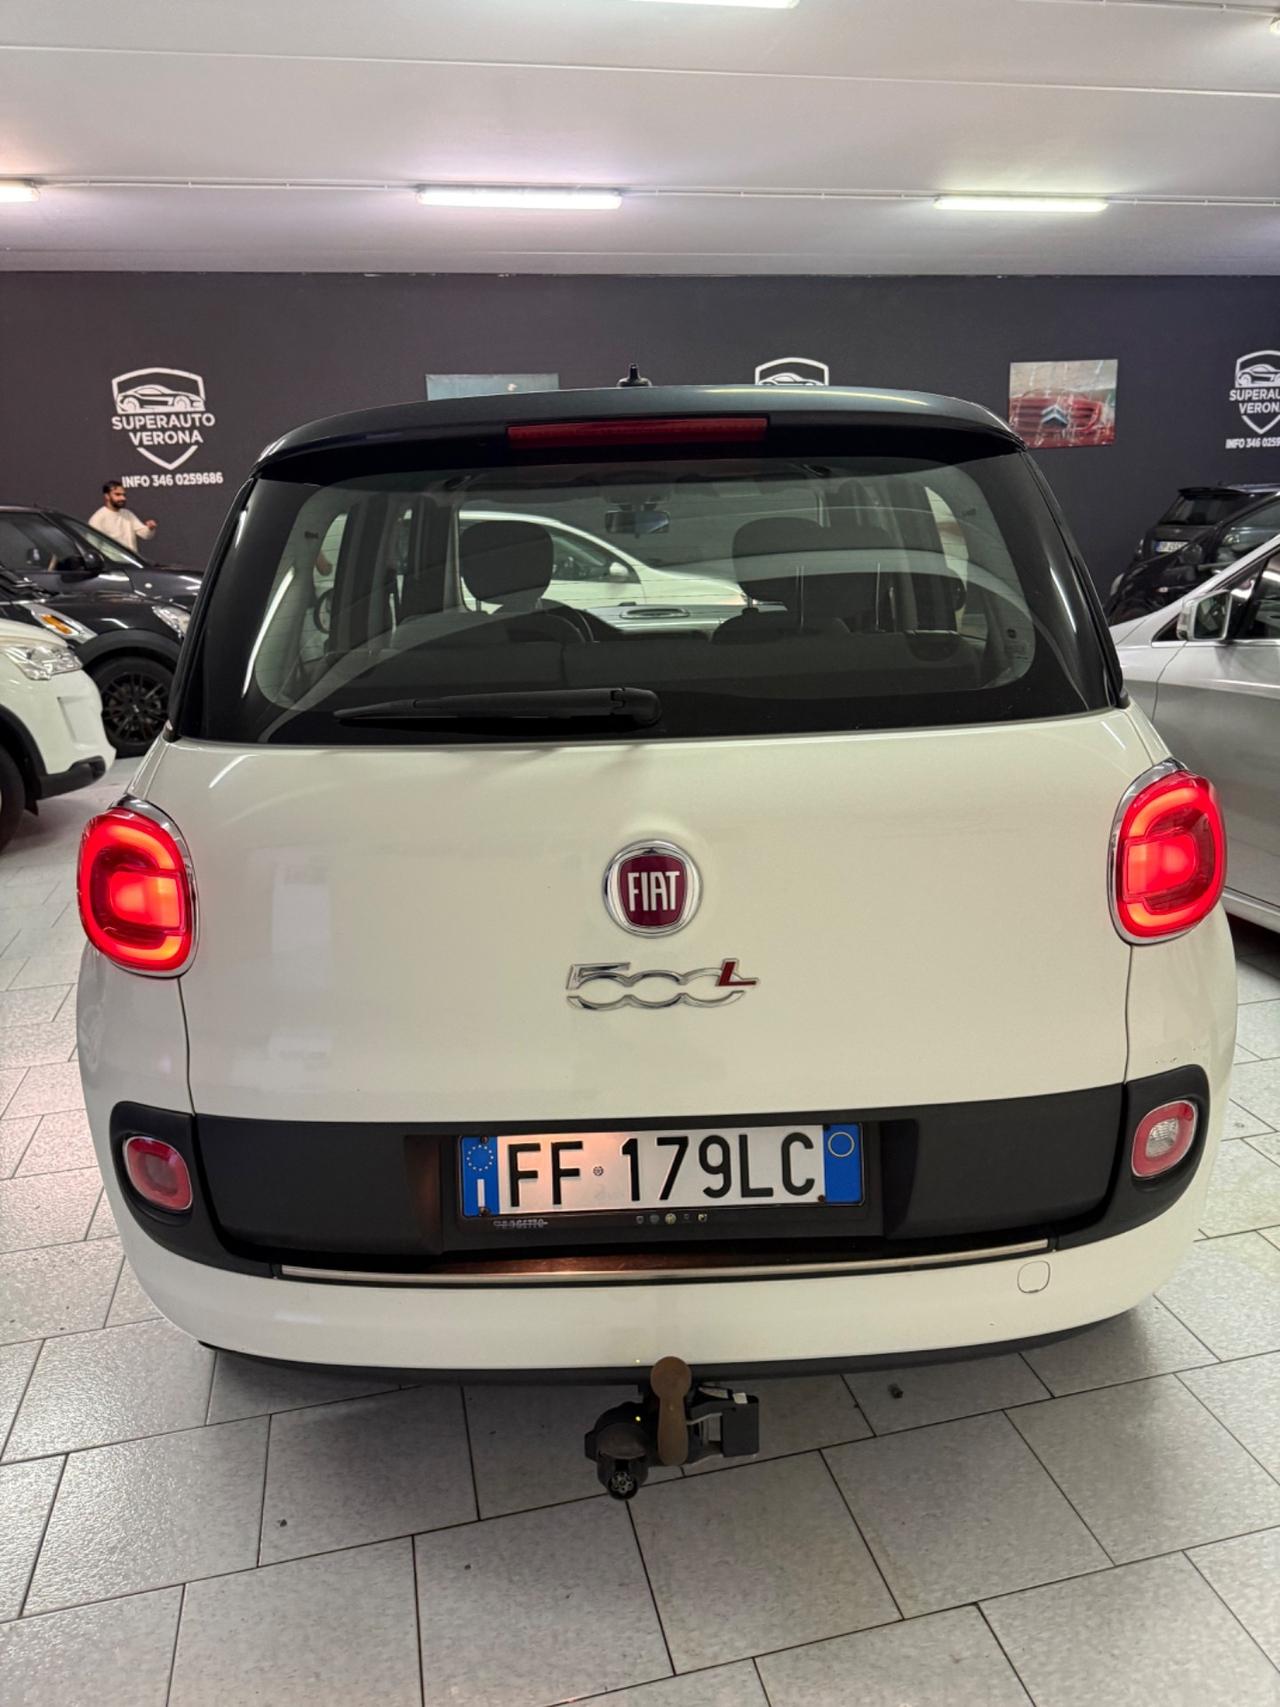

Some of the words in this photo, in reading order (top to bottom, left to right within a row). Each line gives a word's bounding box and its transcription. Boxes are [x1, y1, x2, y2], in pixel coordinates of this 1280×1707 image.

[111, 412, 216, 430] SUPERAUTO
[128, 429, 204, 446] VERONA
[121, 475, 150, 488] INFO
[151, 474, 174, 487] 346
[175, 472, 224, 485] 0259686
[627, 871, 680, 912] FIAT
[565, 957, 760, 1012] 500L
[508, 1140, 583, 1207] FF
[621, 1131, 816, 1202] 179LC
